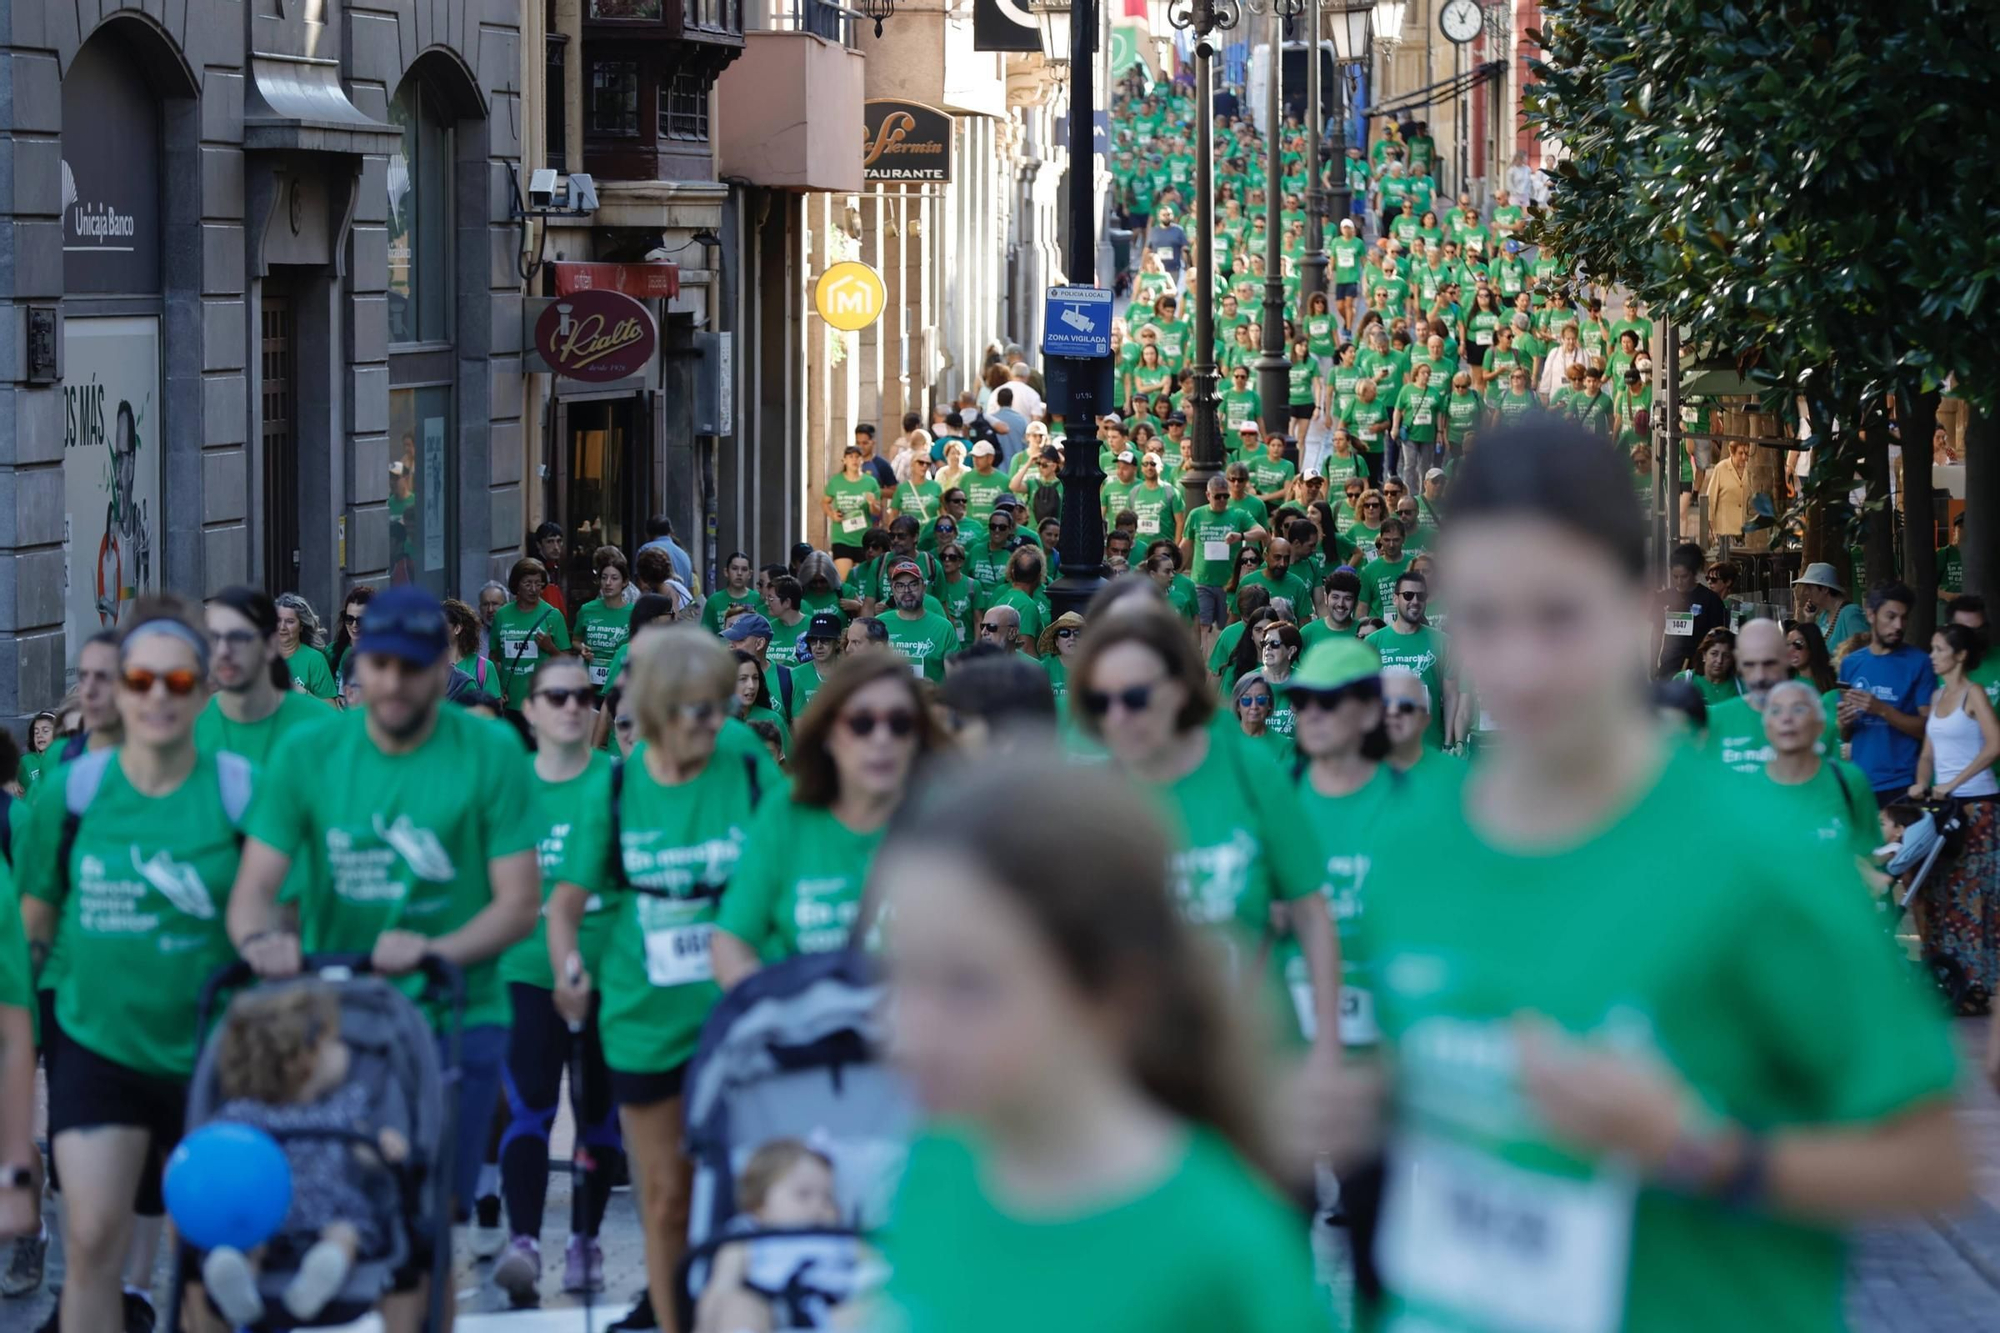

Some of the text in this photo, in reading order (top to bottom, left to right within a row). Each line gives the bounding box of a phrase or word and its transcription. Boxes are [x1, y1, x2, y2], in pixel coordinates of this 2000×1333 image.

[76, 202, 134, 244] Unicaja Banco
[551, 314, 645, 369] Rialto
[1070, 335, 1106, 344] VIGILADA
[80, 372, 105, 447] MÁS
[1672, 620, 1688, 628] 1447
[1382, 654, 1429, 664] En marcha
